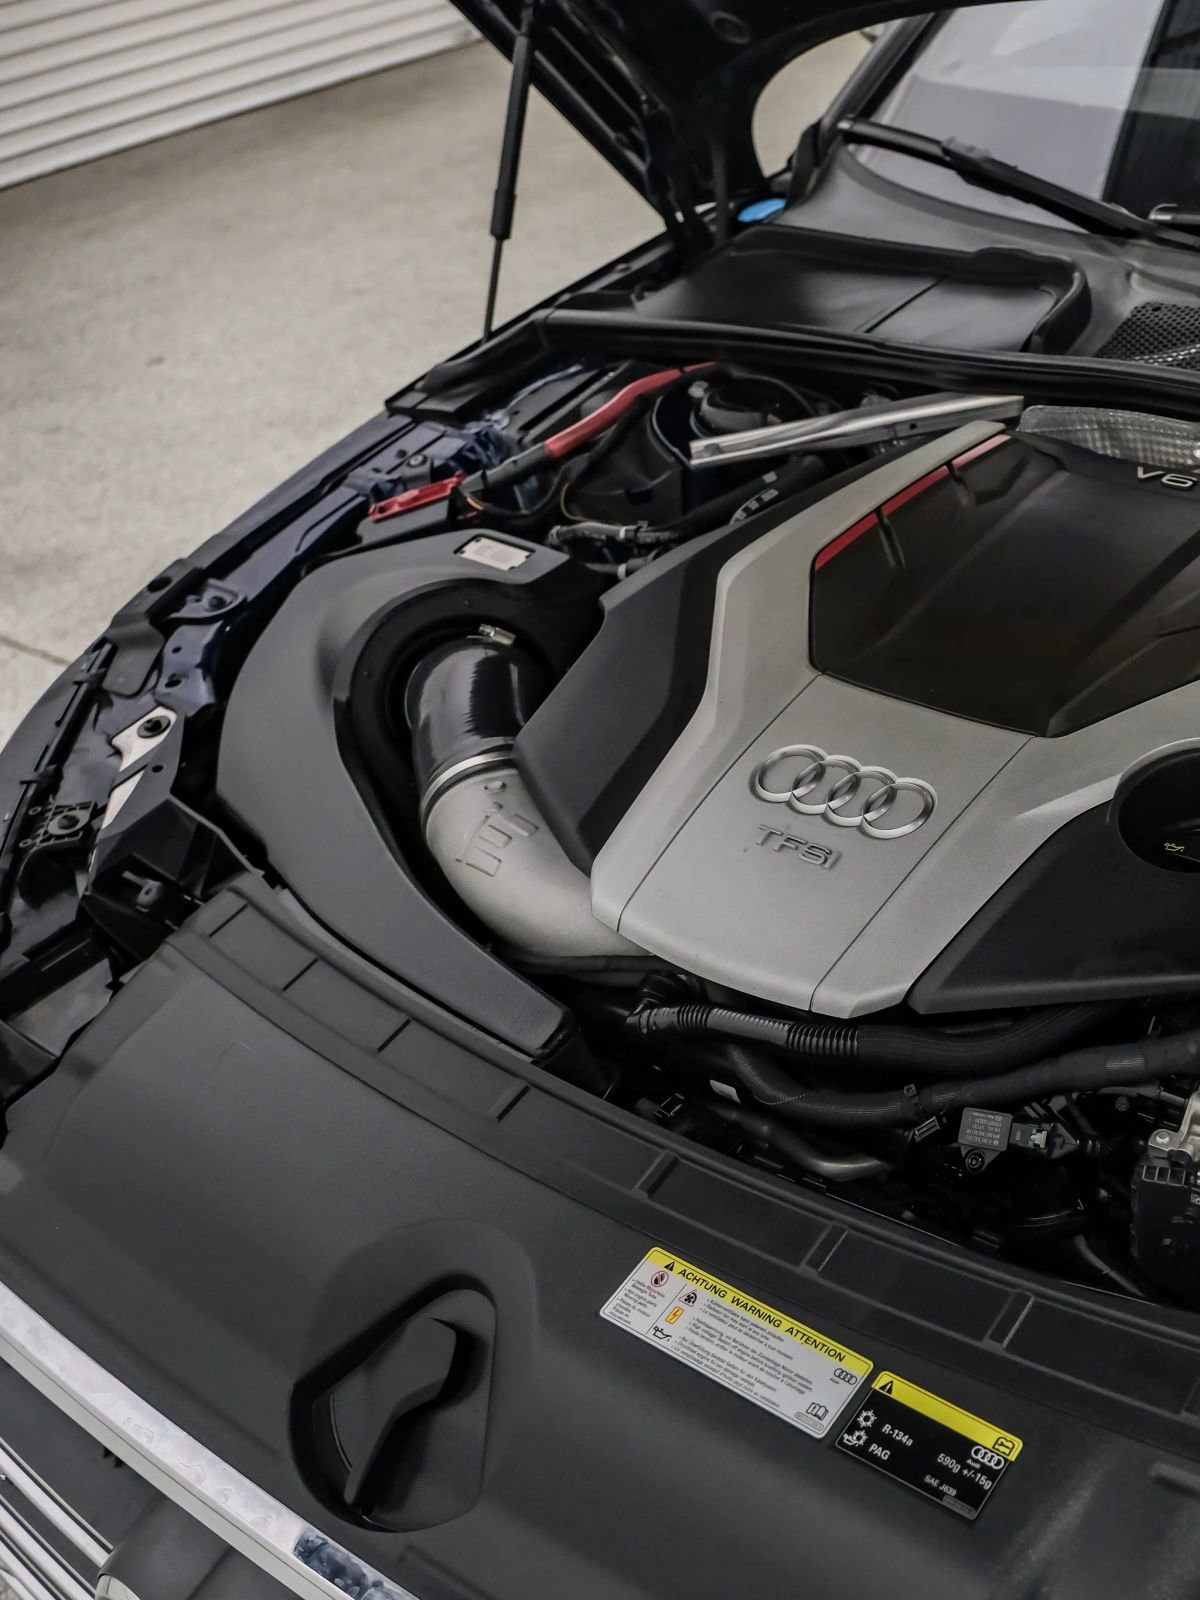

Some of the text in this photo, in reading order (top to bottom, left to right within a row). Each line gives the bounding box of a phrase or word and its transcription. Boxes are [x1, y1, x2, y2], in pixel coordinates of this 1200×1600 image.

[1137, 466, 1198, 488] V6
[755, 823, 843, 871] TFSI
[677, 1268, 727, 1299] ACHTUNG
[731, 1296, 783, 1328] WARNING
[785, 1326, 846, 1363] ATTENTION
[881, 1423, 914, 1447] R-134a
[868, 1443, 891, 1461] PAG
[924, 1475, 939, 1488] SAE
[936, 1453, 993, 1491] 590g +/-15g
